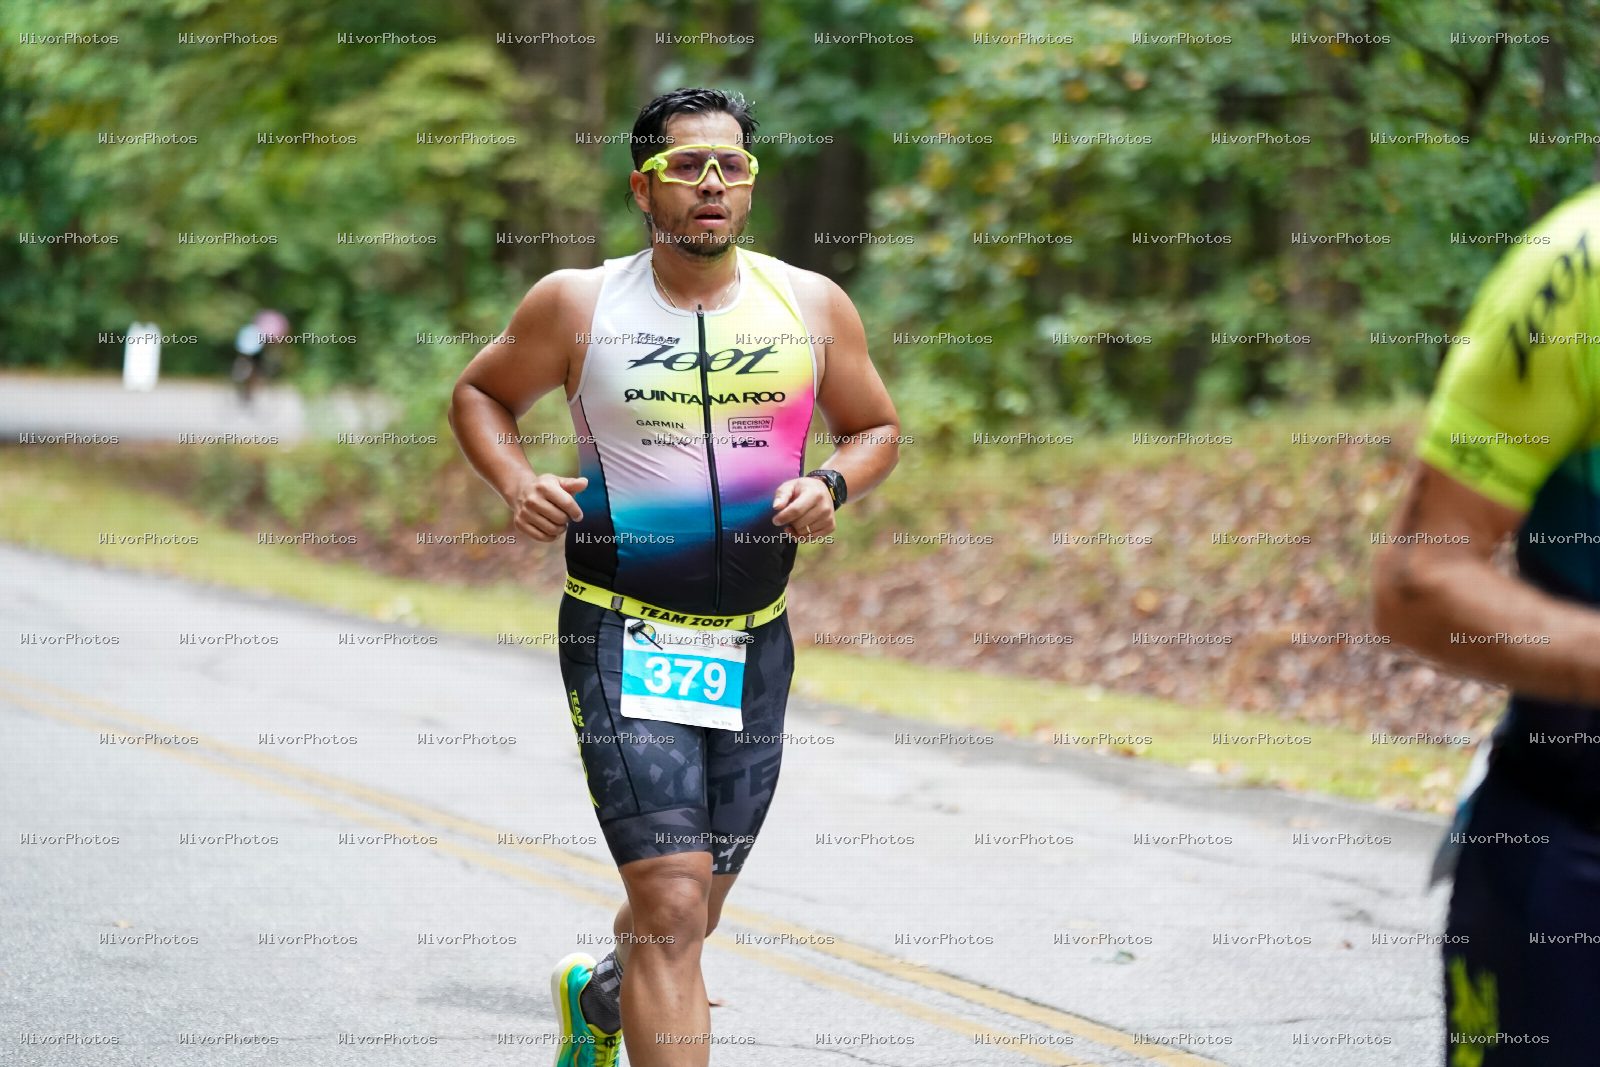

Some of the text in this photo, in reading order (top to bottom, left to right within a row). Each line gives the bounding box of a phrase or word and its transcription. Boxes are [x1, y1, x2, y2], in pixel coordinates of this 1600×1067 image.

[742, 390, 786, 405] ROO
[636, 419, 685, 430] GARMIN
[640, 606, 735, 628] TEAM ZOOT
[644, 656, 727, 701] 379
[569, 689, 585, 728] TEAM
